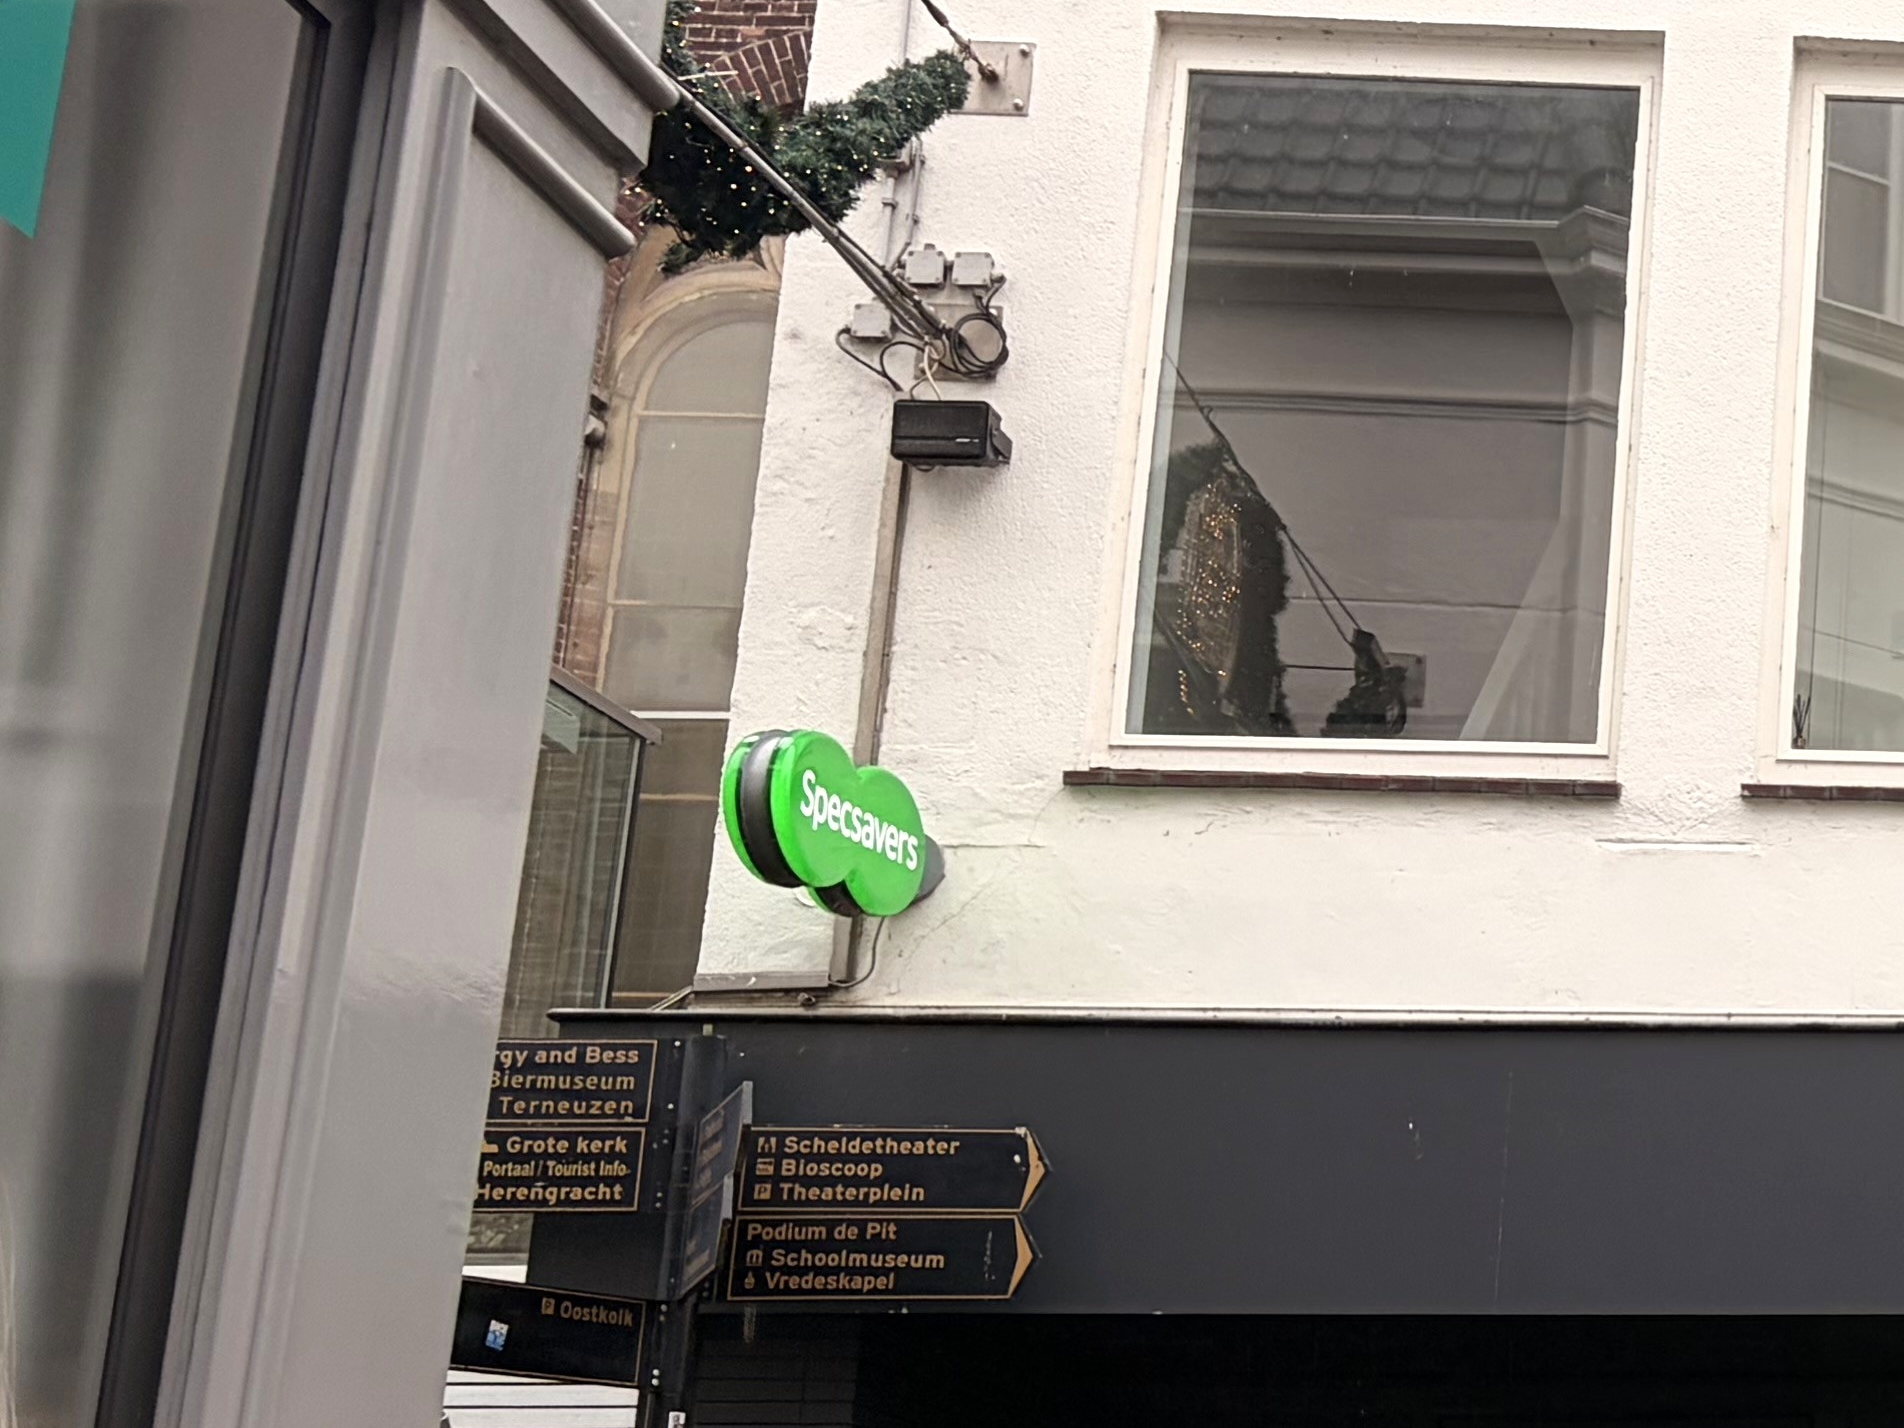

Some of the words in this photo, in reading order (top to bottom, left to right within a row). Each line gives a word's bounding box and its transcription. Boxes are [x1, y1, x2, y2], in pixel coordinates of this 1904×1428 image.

[800, 769, 919, 871] Specsavers
[535, 1047, 577, 1064] and
[585, 1046, 639, 1064] Bess
[490, 1070, 635, 1090] Biermuseum
[500, 1096, 634, 1114] Terneuzen
[506, 1136, 569, 1153] Grote
[576, 1136, 628, 1153] kerk
[783, 1136, 960, 1155] Scheldetheater
[483, 1160, 535, 1177] Portaal
[546, 1160, 595, 1177] Tourist
[781, 1158, 883, 1179] Bioscoop
[477, 1183, 624, 1205] Herengracht
[779, 1183, 925, 1204] Theaterplein
[747, 1223, 827, 1241] Podium
[833, 1223, 859, 1241] de
[866, 1222, 897, 1240] Pit
[771, 1249, 946, 1269] Schoolmuseum
[765, 1272, 895, 1293] Vredeskapel
[560, 1300, 633, 1328] Oostkolk
